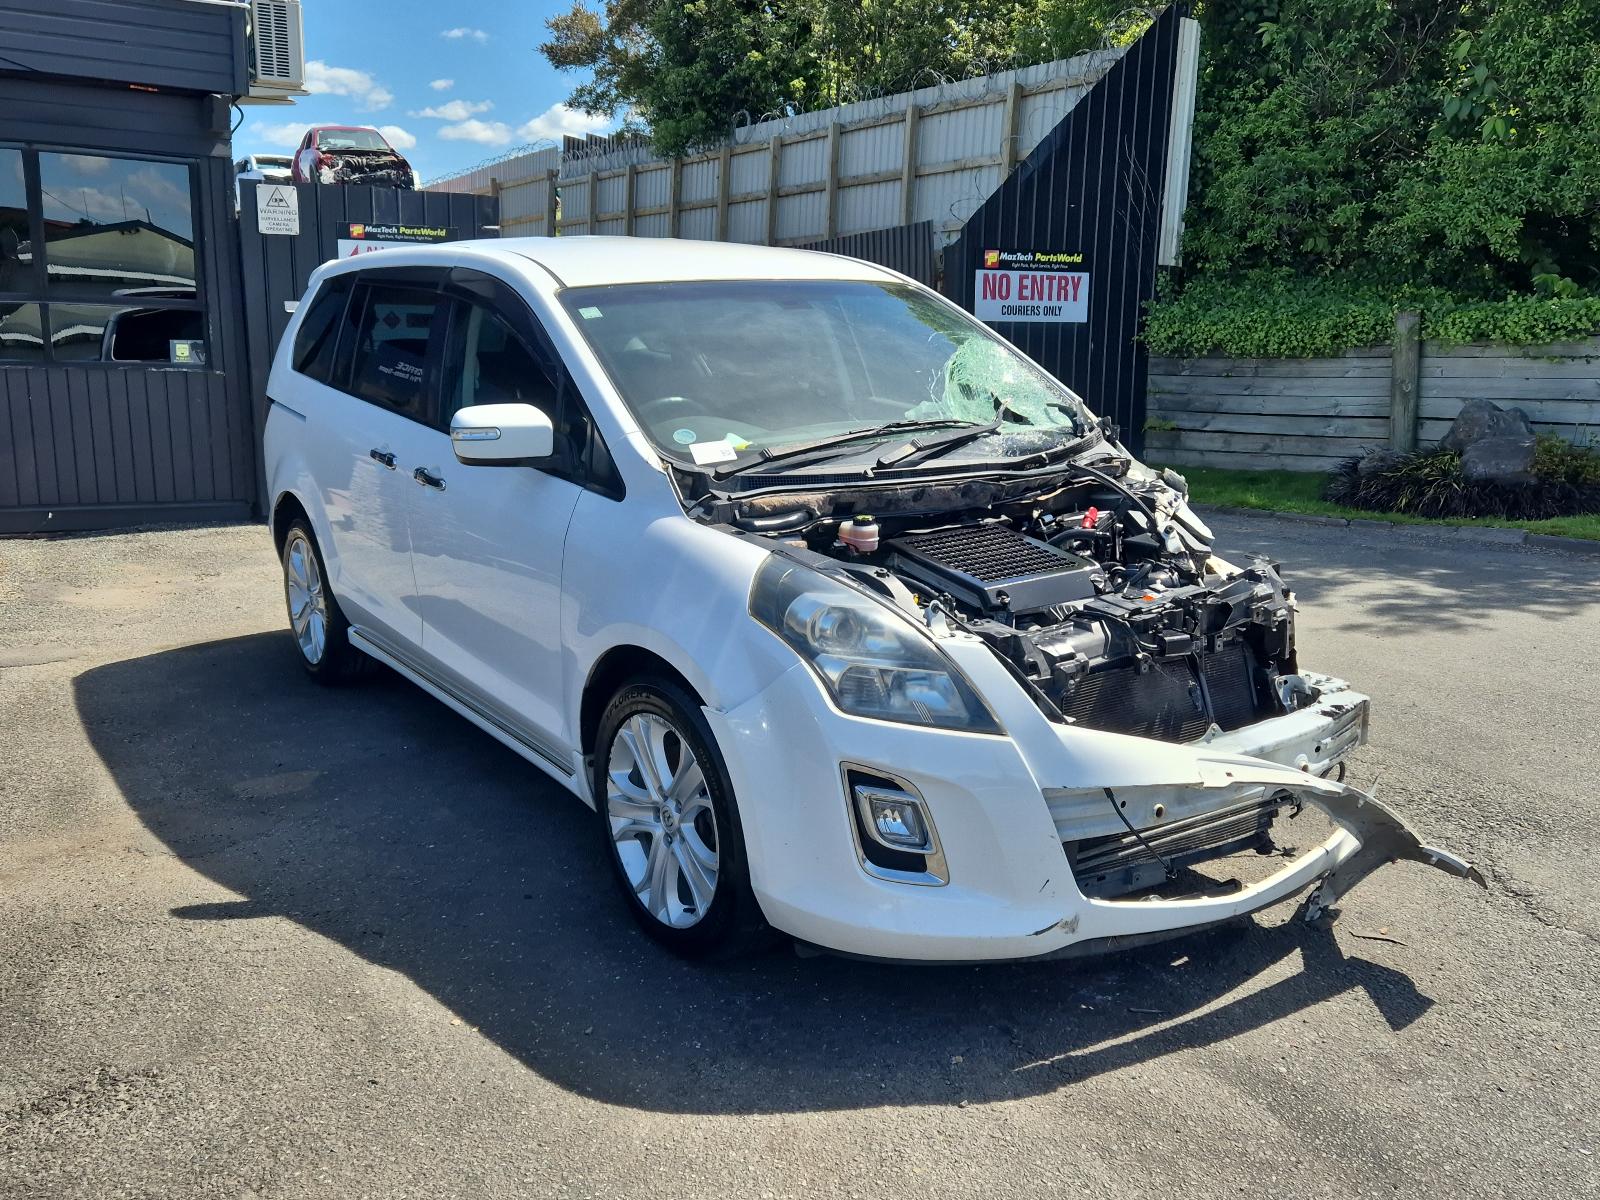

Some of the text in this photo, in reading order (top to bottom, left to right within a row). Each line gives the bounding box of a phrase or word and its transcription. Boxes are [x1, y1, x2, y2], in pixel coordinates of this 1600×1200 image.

[399, 226, 446, 236] PartsWorld
[1035, 253, 1082, 263] PartsWorld
[982, 272, 1082, 302] NO ENTRY
[1001, 304, 1062, 316] COURIERS ONLY
